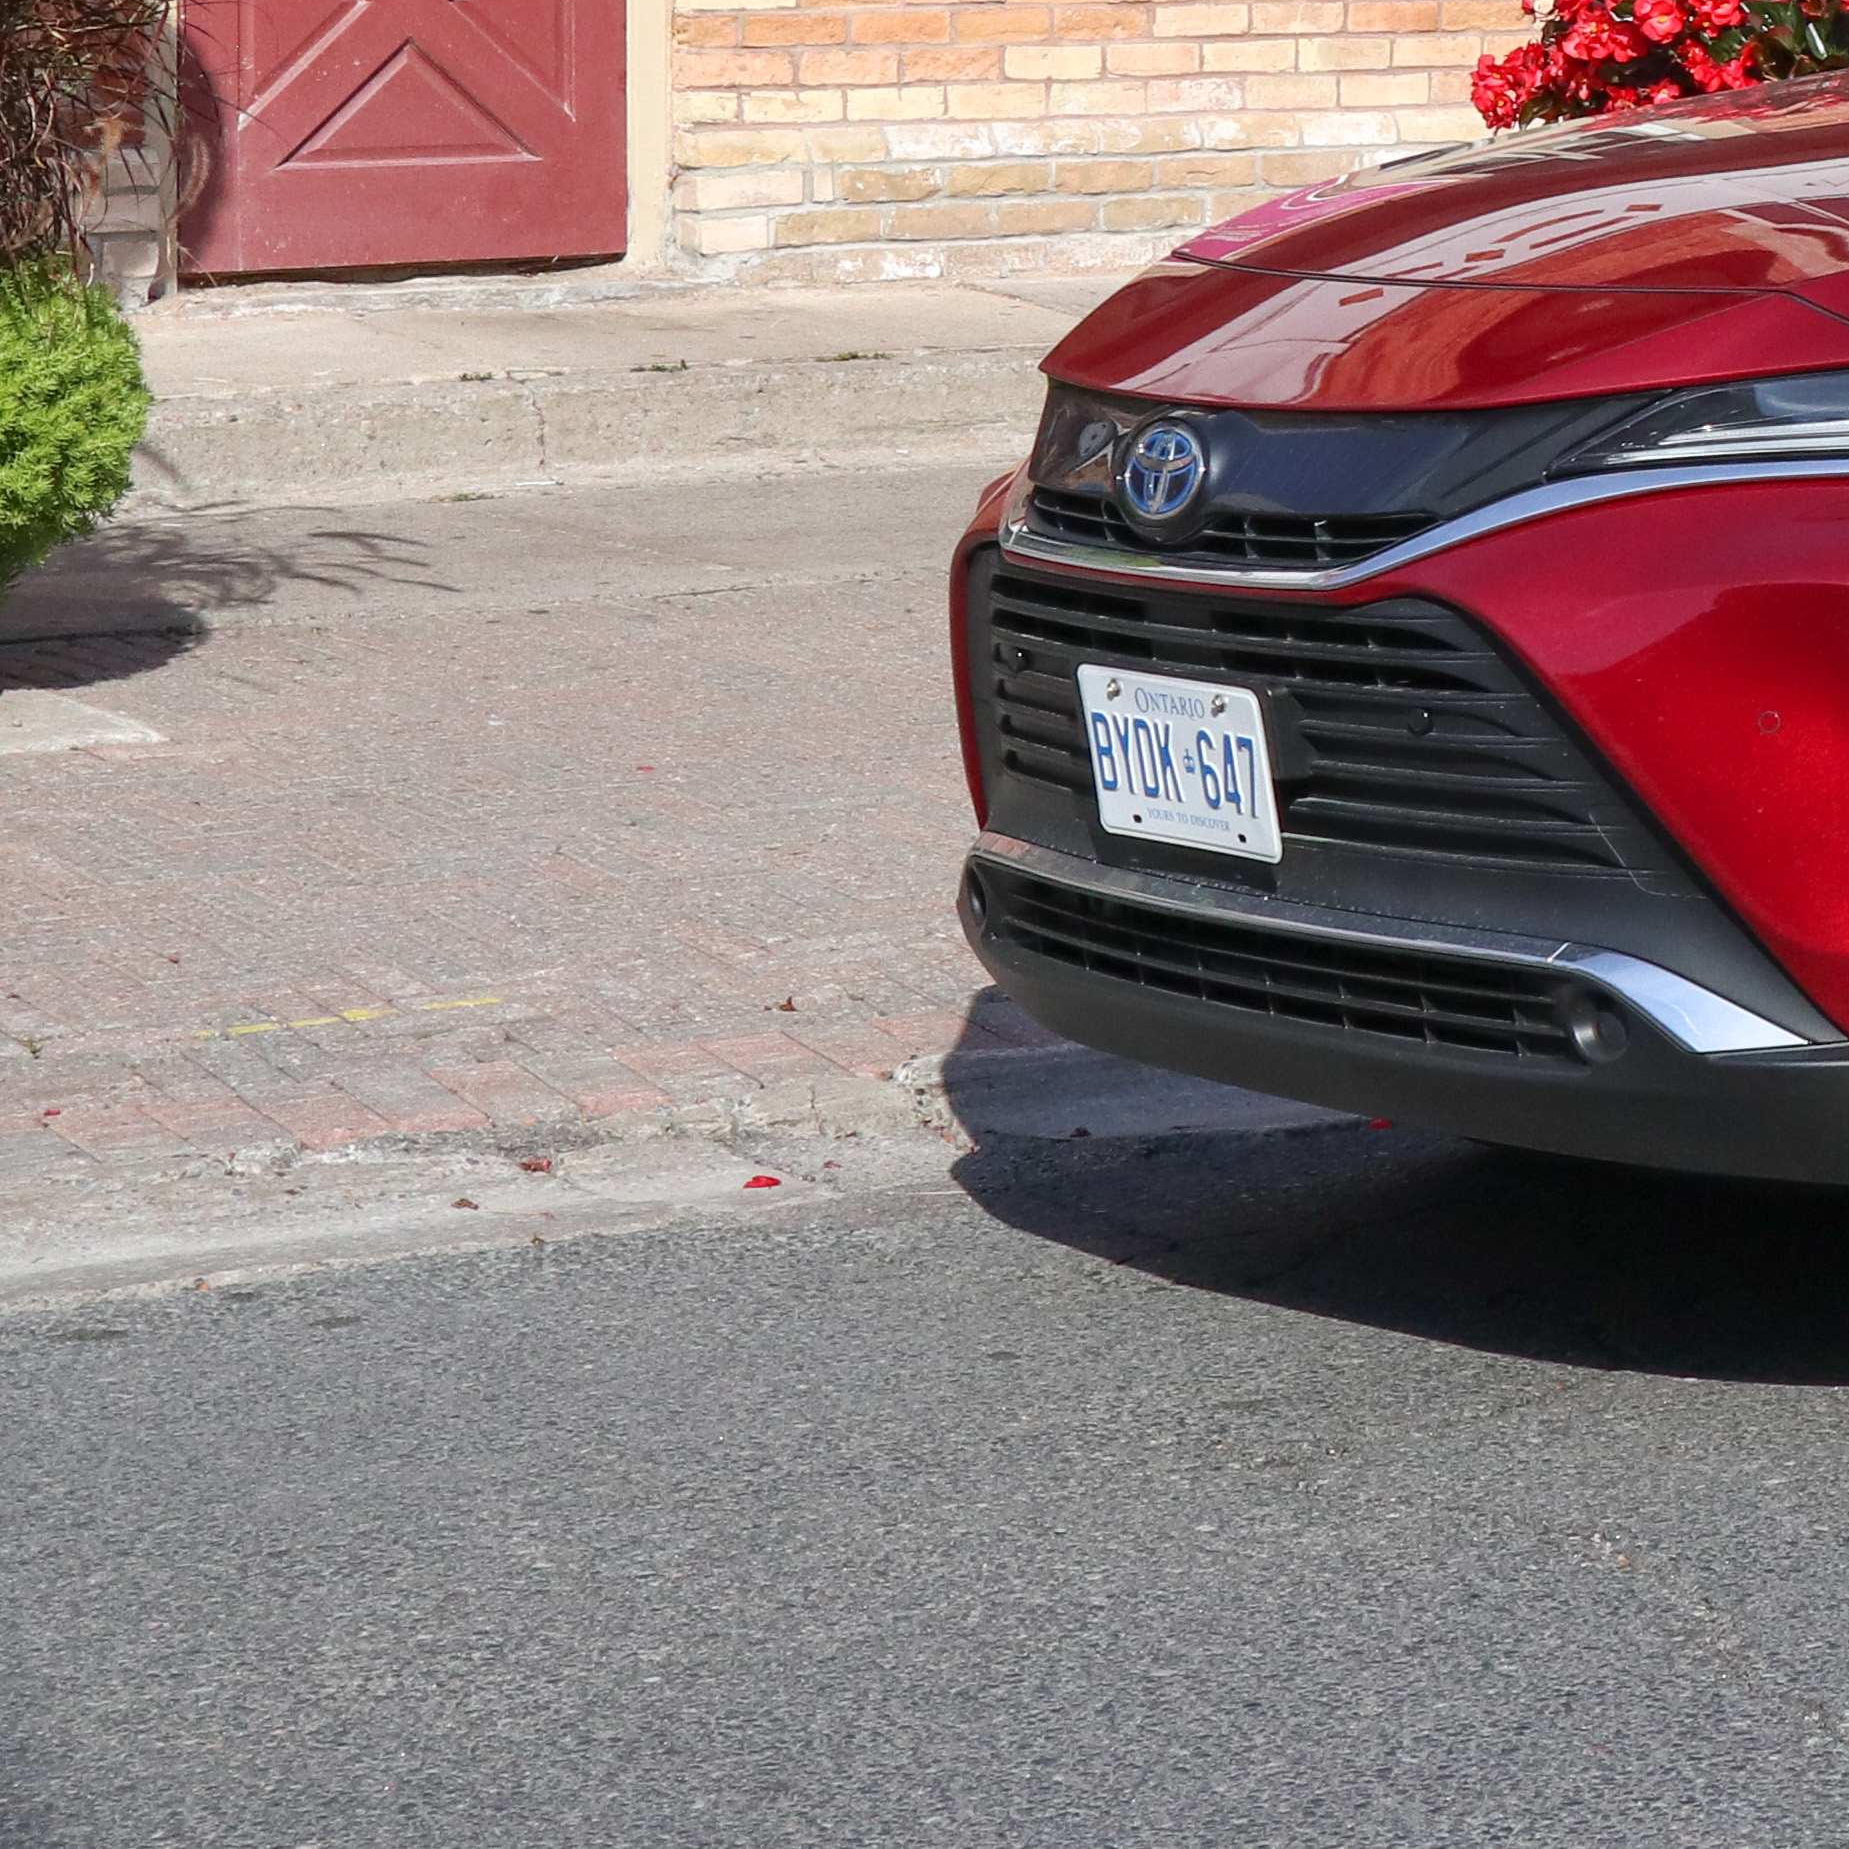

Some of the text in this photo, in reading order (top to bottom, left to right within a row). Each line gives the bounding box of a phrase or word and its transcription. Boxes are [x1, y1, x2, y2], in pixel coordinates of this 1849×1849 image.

[1134, 687, 1205, 721] ONTARIO
[1092, 711, 1259, 819] BYDK 647
[1147, 807, 1231, 832] YOURS TO DISCOVER
